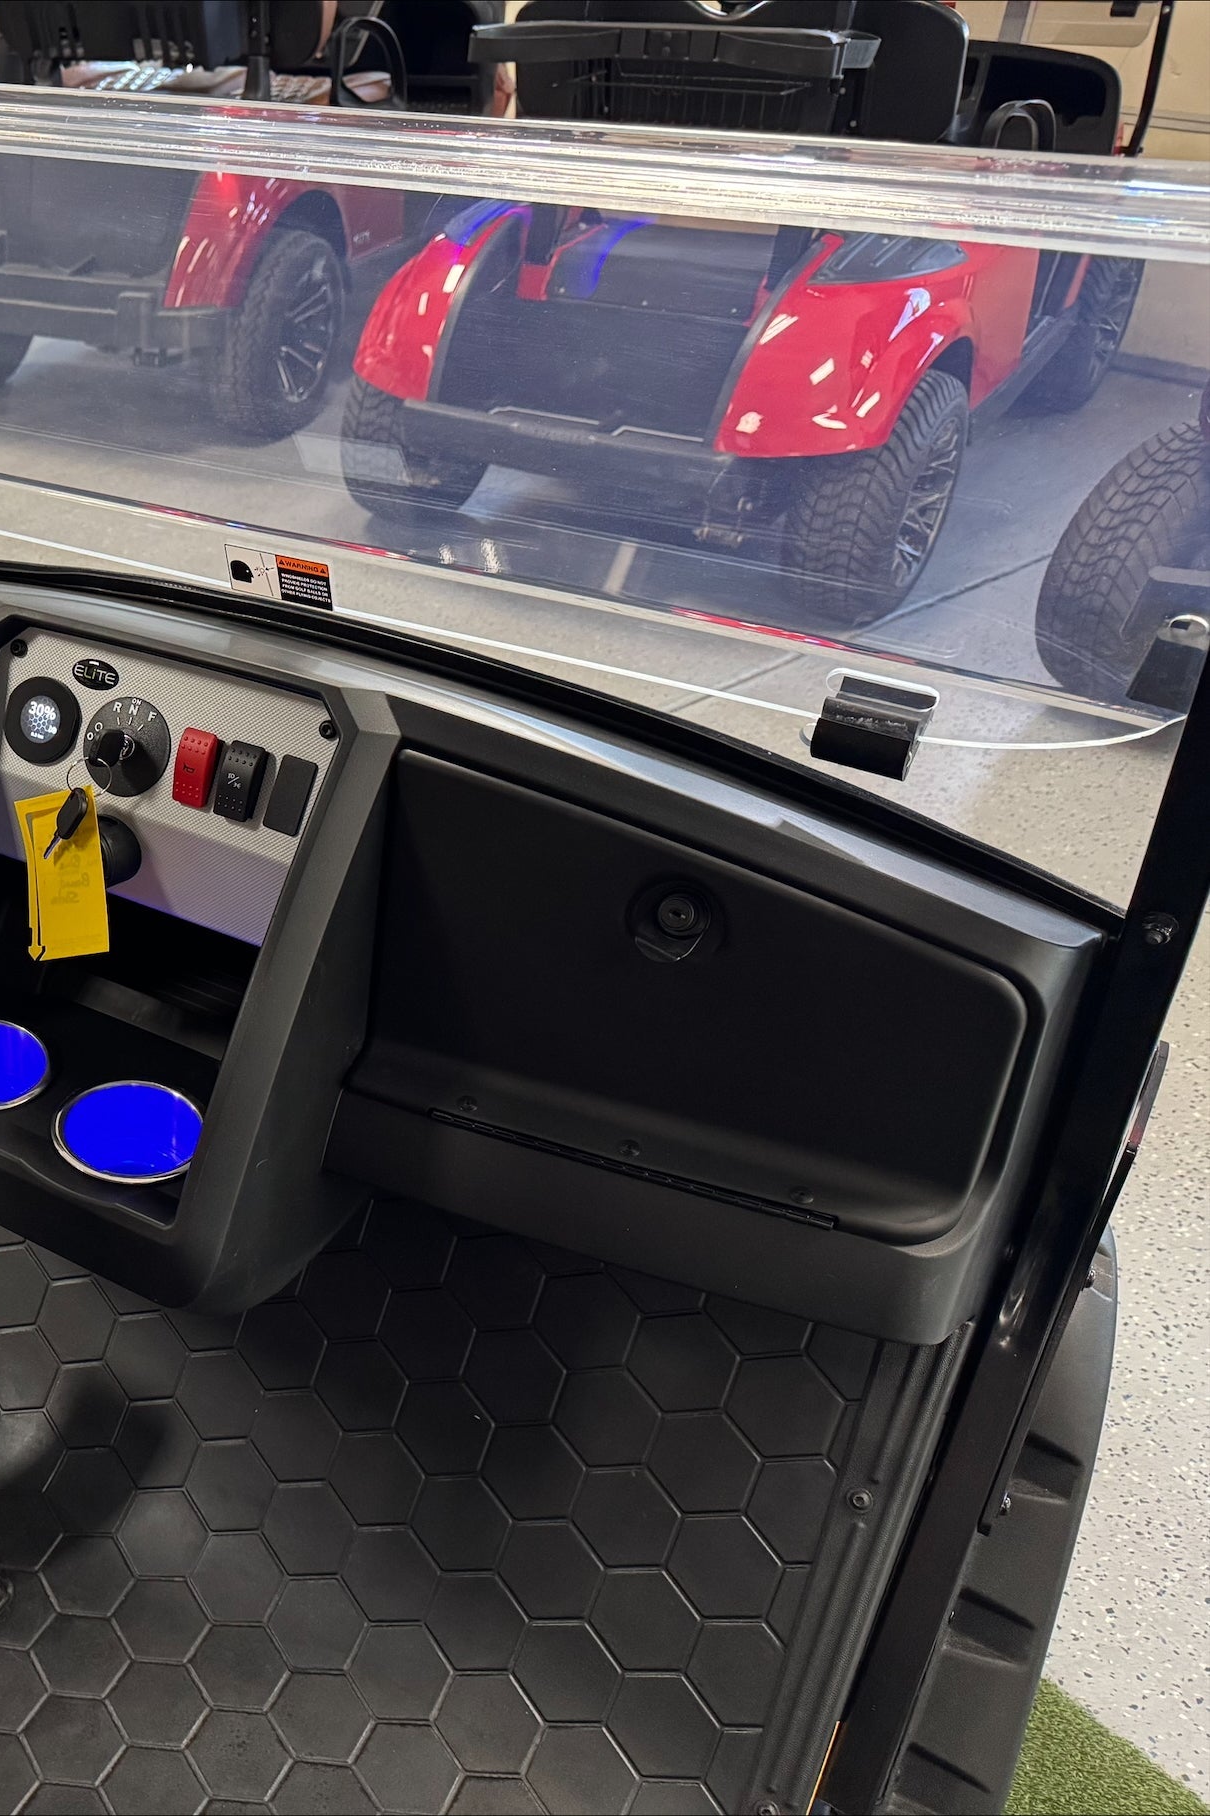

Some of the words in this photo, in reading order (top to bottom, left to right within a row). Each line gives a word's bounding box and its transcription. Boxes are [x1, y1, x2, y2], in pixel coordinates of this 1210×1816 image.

[285, 560, 319, 573] WARNING
[113, 702, 122, 713] R
[131, 698, 143, 706] ON
[29, 701, 57, 720] 30%
[129, 704, 139, 716] N
[148, 711, 157, 721] F
